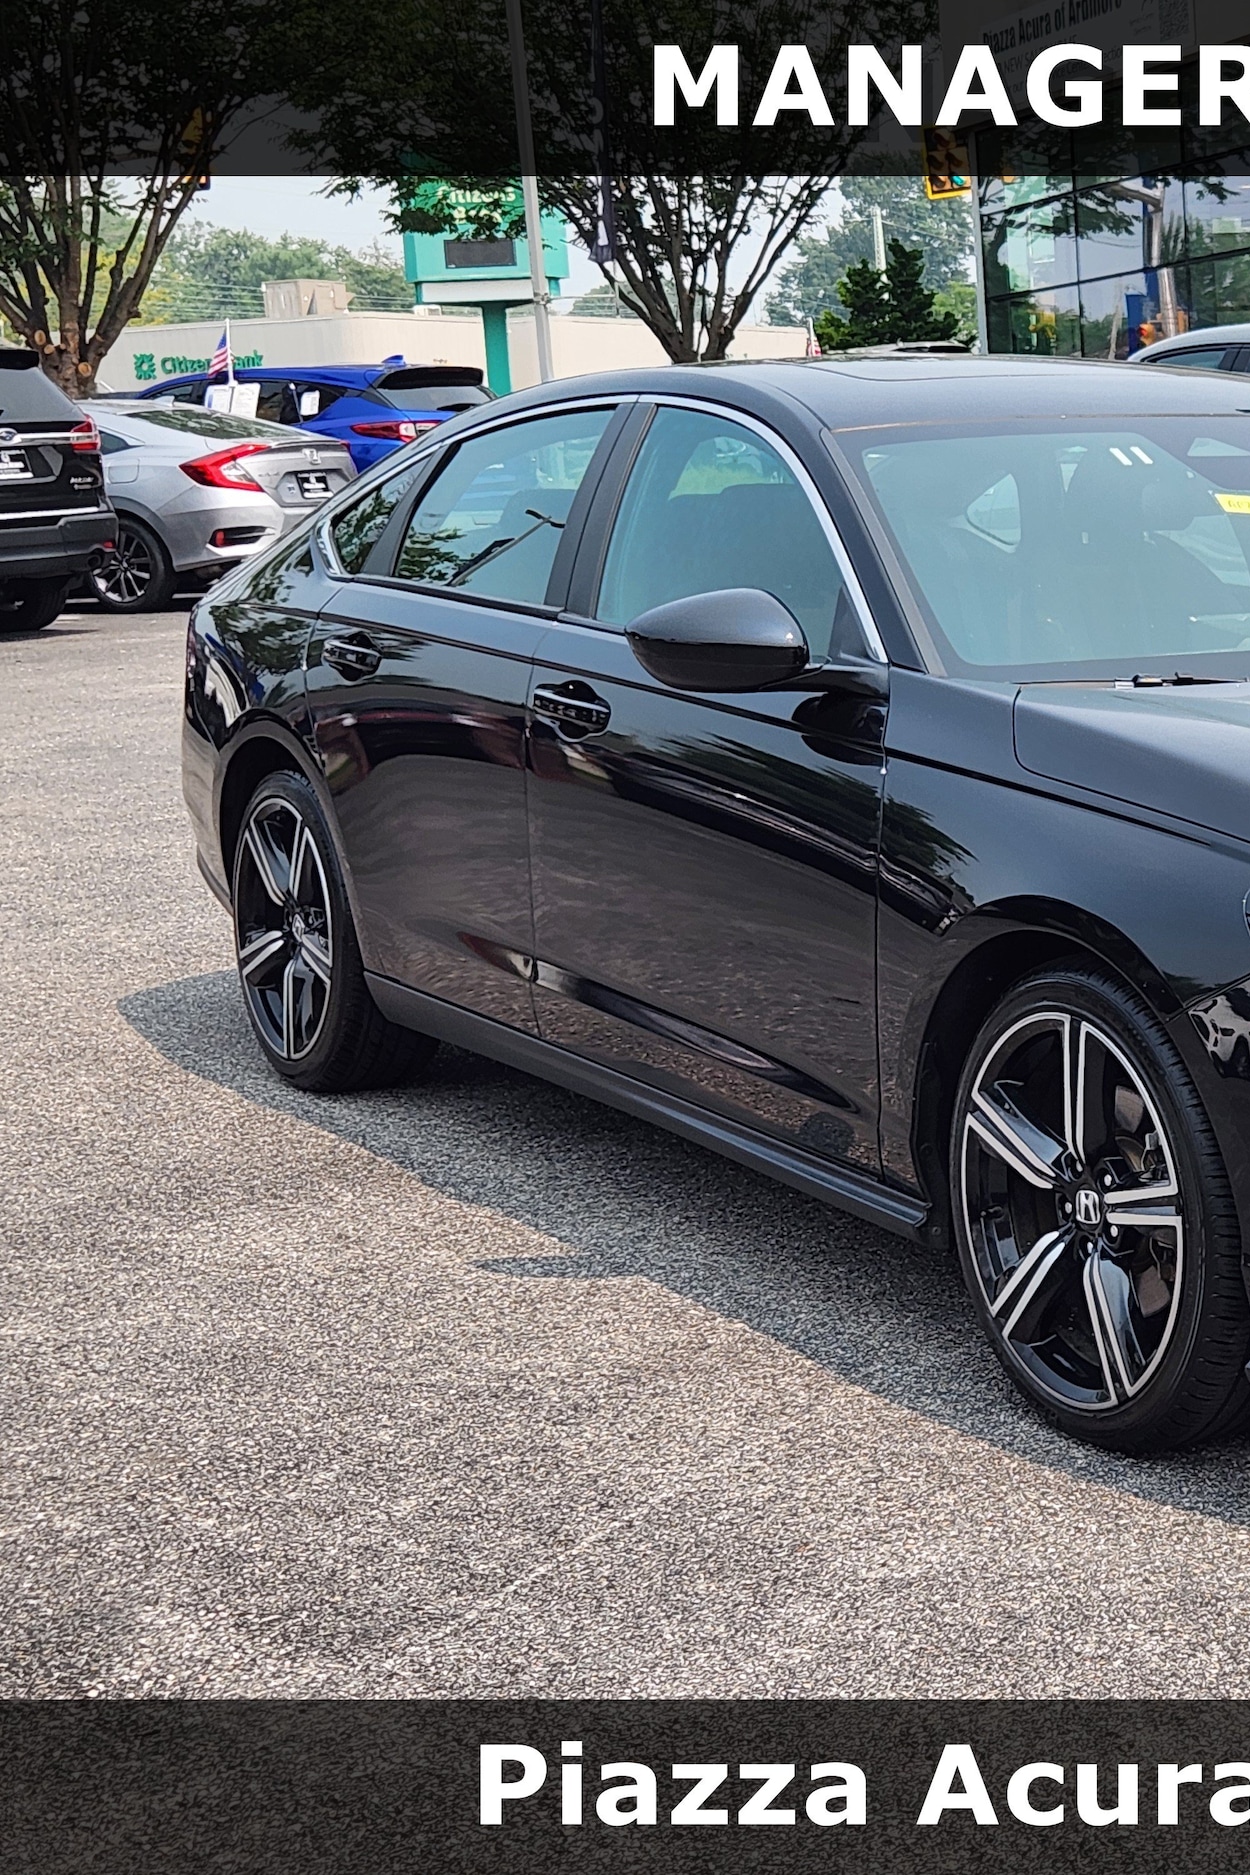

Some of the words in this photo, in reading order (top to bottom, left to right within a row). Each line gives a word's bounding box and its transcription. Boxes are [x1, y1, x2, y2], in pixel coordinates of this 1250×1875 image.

[1018, 12, 1051, 46] Acura
[1054, 2, 1066, 31] of
[160, 356, 213, 375] Citizen
